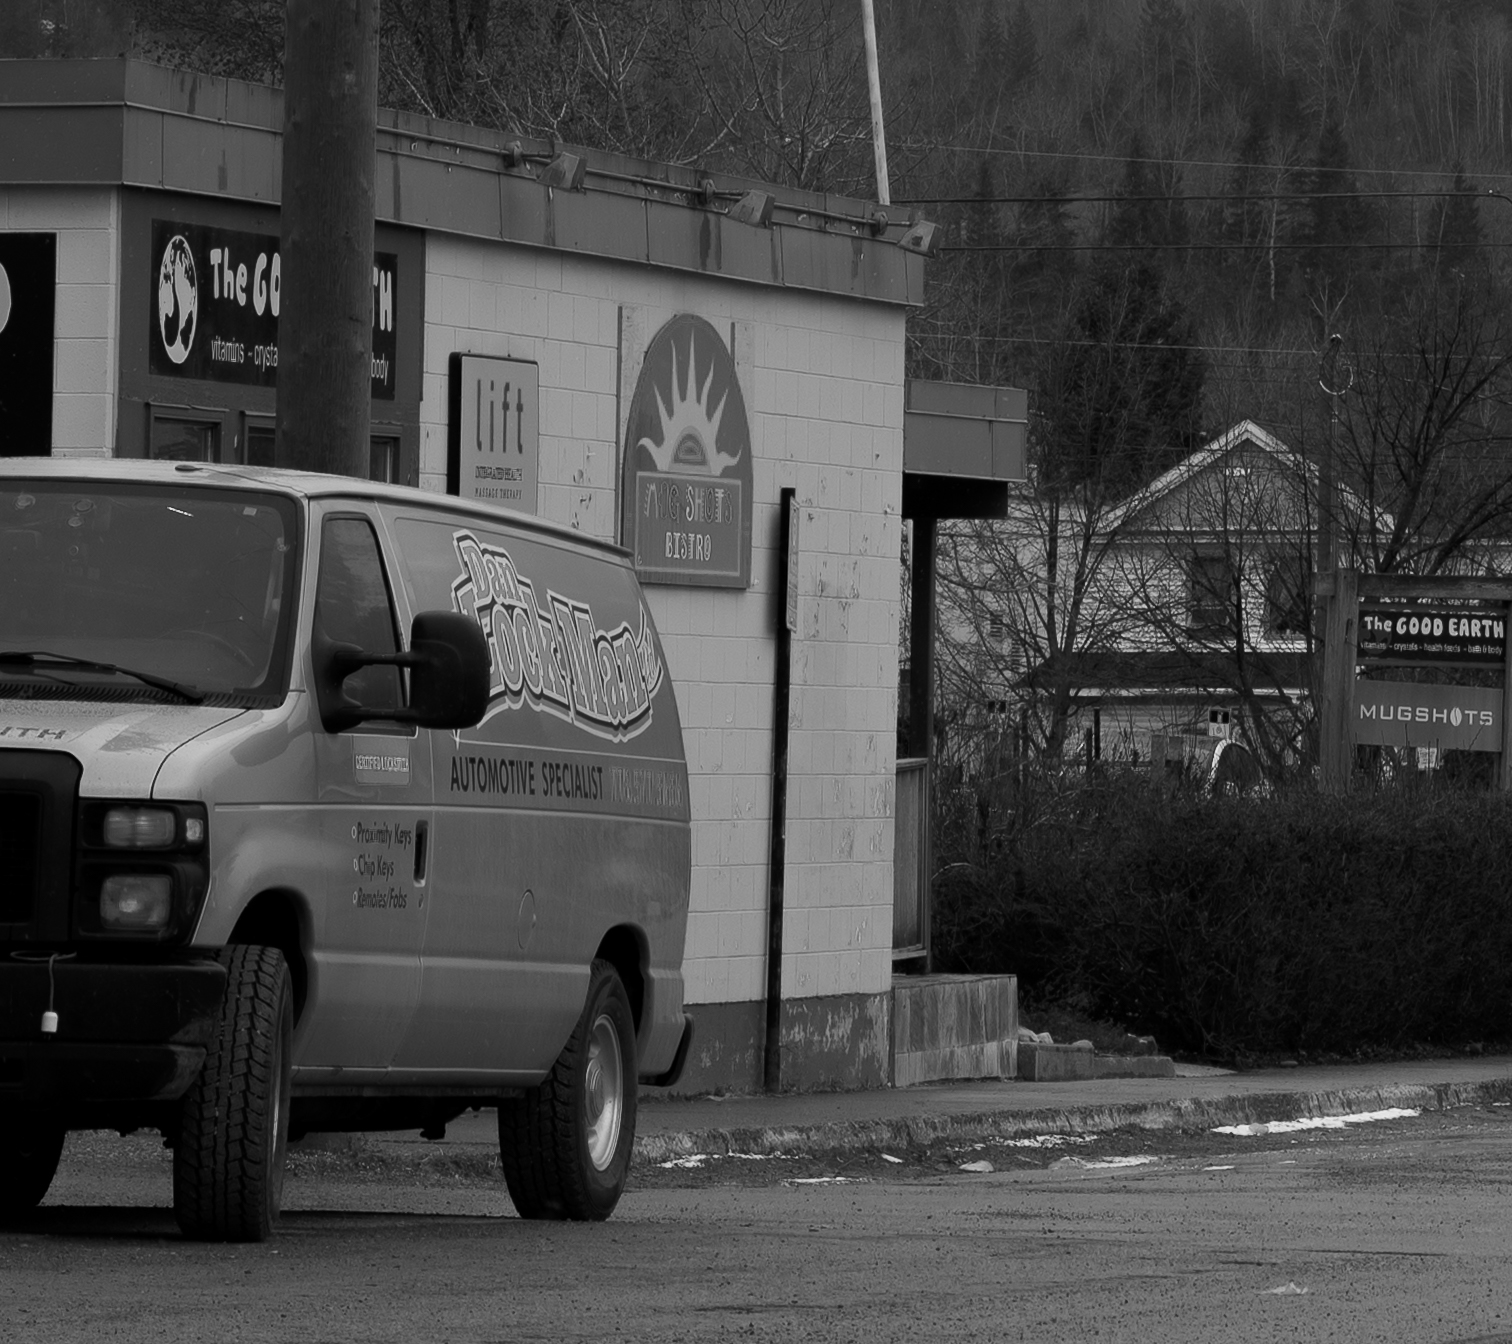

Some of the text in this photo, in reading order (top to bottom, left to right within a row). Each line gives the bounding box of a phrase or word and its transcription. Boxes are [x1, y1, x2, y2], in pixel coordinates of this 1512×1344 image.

[210, 247, 281, 317] The GO
[211, 335, 245, 364] vitamins
[254, 342, 278, 372] crysta
[476, 379, 523, 454] lift
[474, 487, 523, 500] MASSAGE THERAPY
[644, 481, 732, 524] MUG SHOTS
[665, 532, 711, 562] BISTRO
[458, 540, 524, 604] Dan
[1364, 616, 1504, 639] The GOOD EARTH
[1360, 642, 1387, 650] vitamins
[1393, 642, 1418, 652] crystals
[1423, 643, 1443, 651] health
[1444, 643, 1461, 653] foods
[1467, 644, 1481, 653] bath
[1488, 645, 1503, 656] body
[1360, 704, 1493, 726] MUGSHOTS
[450, 756, 536, 796] AUTOMOTIVE
[542, 761, 603, 800] SPECIALIST
[357, 822, 412, 850] Proximity Keys
[359, 854, 394, 882] Chip Keys
[357, 886, 407, 909] Remotes/Fobs
